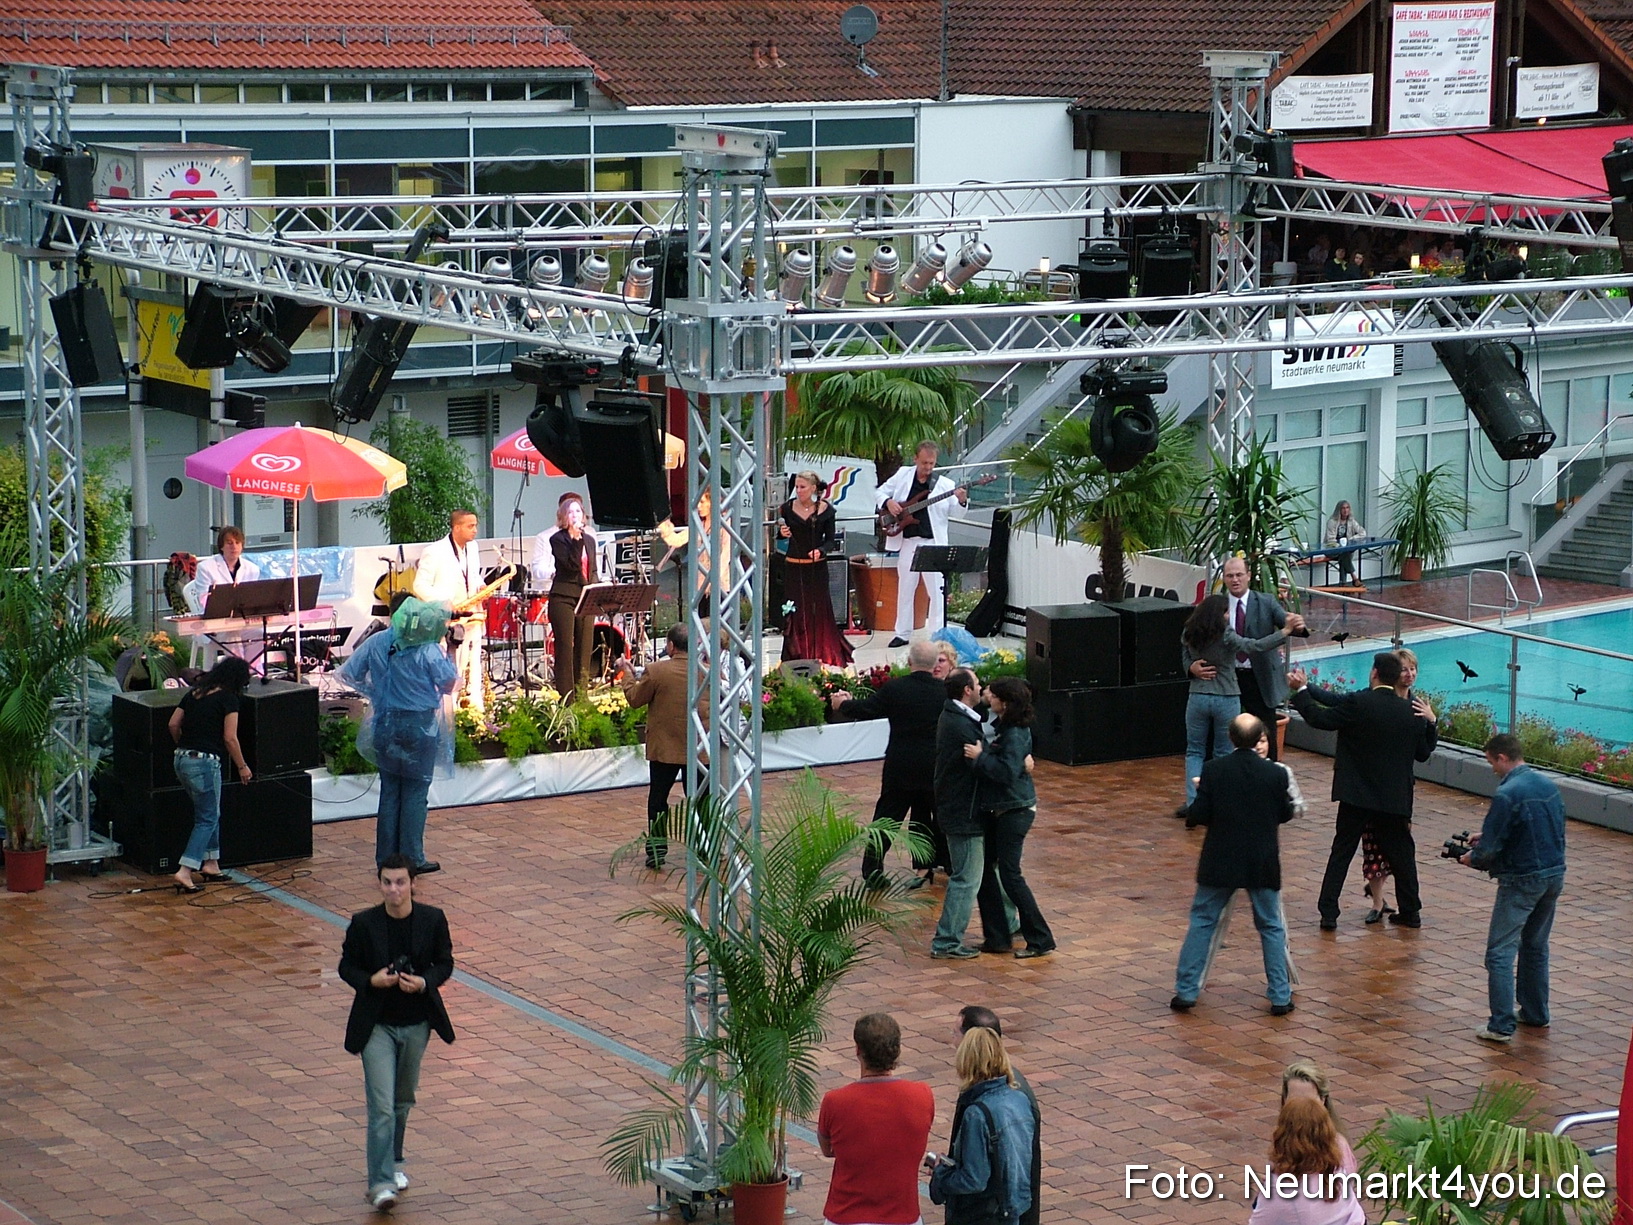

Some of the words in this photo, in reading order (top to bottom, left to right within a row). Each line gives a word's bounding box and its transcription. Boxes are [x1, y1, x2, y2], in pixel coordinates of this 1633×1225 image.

[1409, 10, 1423, 20] TABAC
[1427, 10, 1448, 20] MEXICAN
[1449, 10, 1458, 19] BAR
[1464, 8, 1492, 18] RESTAURANT
[1533, 81, 1565, 91] Sonntagsbrunch
[1282, 364, 1324, 378] stadtwerke
[1326, 360, 1366, 373] neumarkt
[497, 456, 536, 472] LANGNESE
[236, 478, 301, 494] LANGNESE
